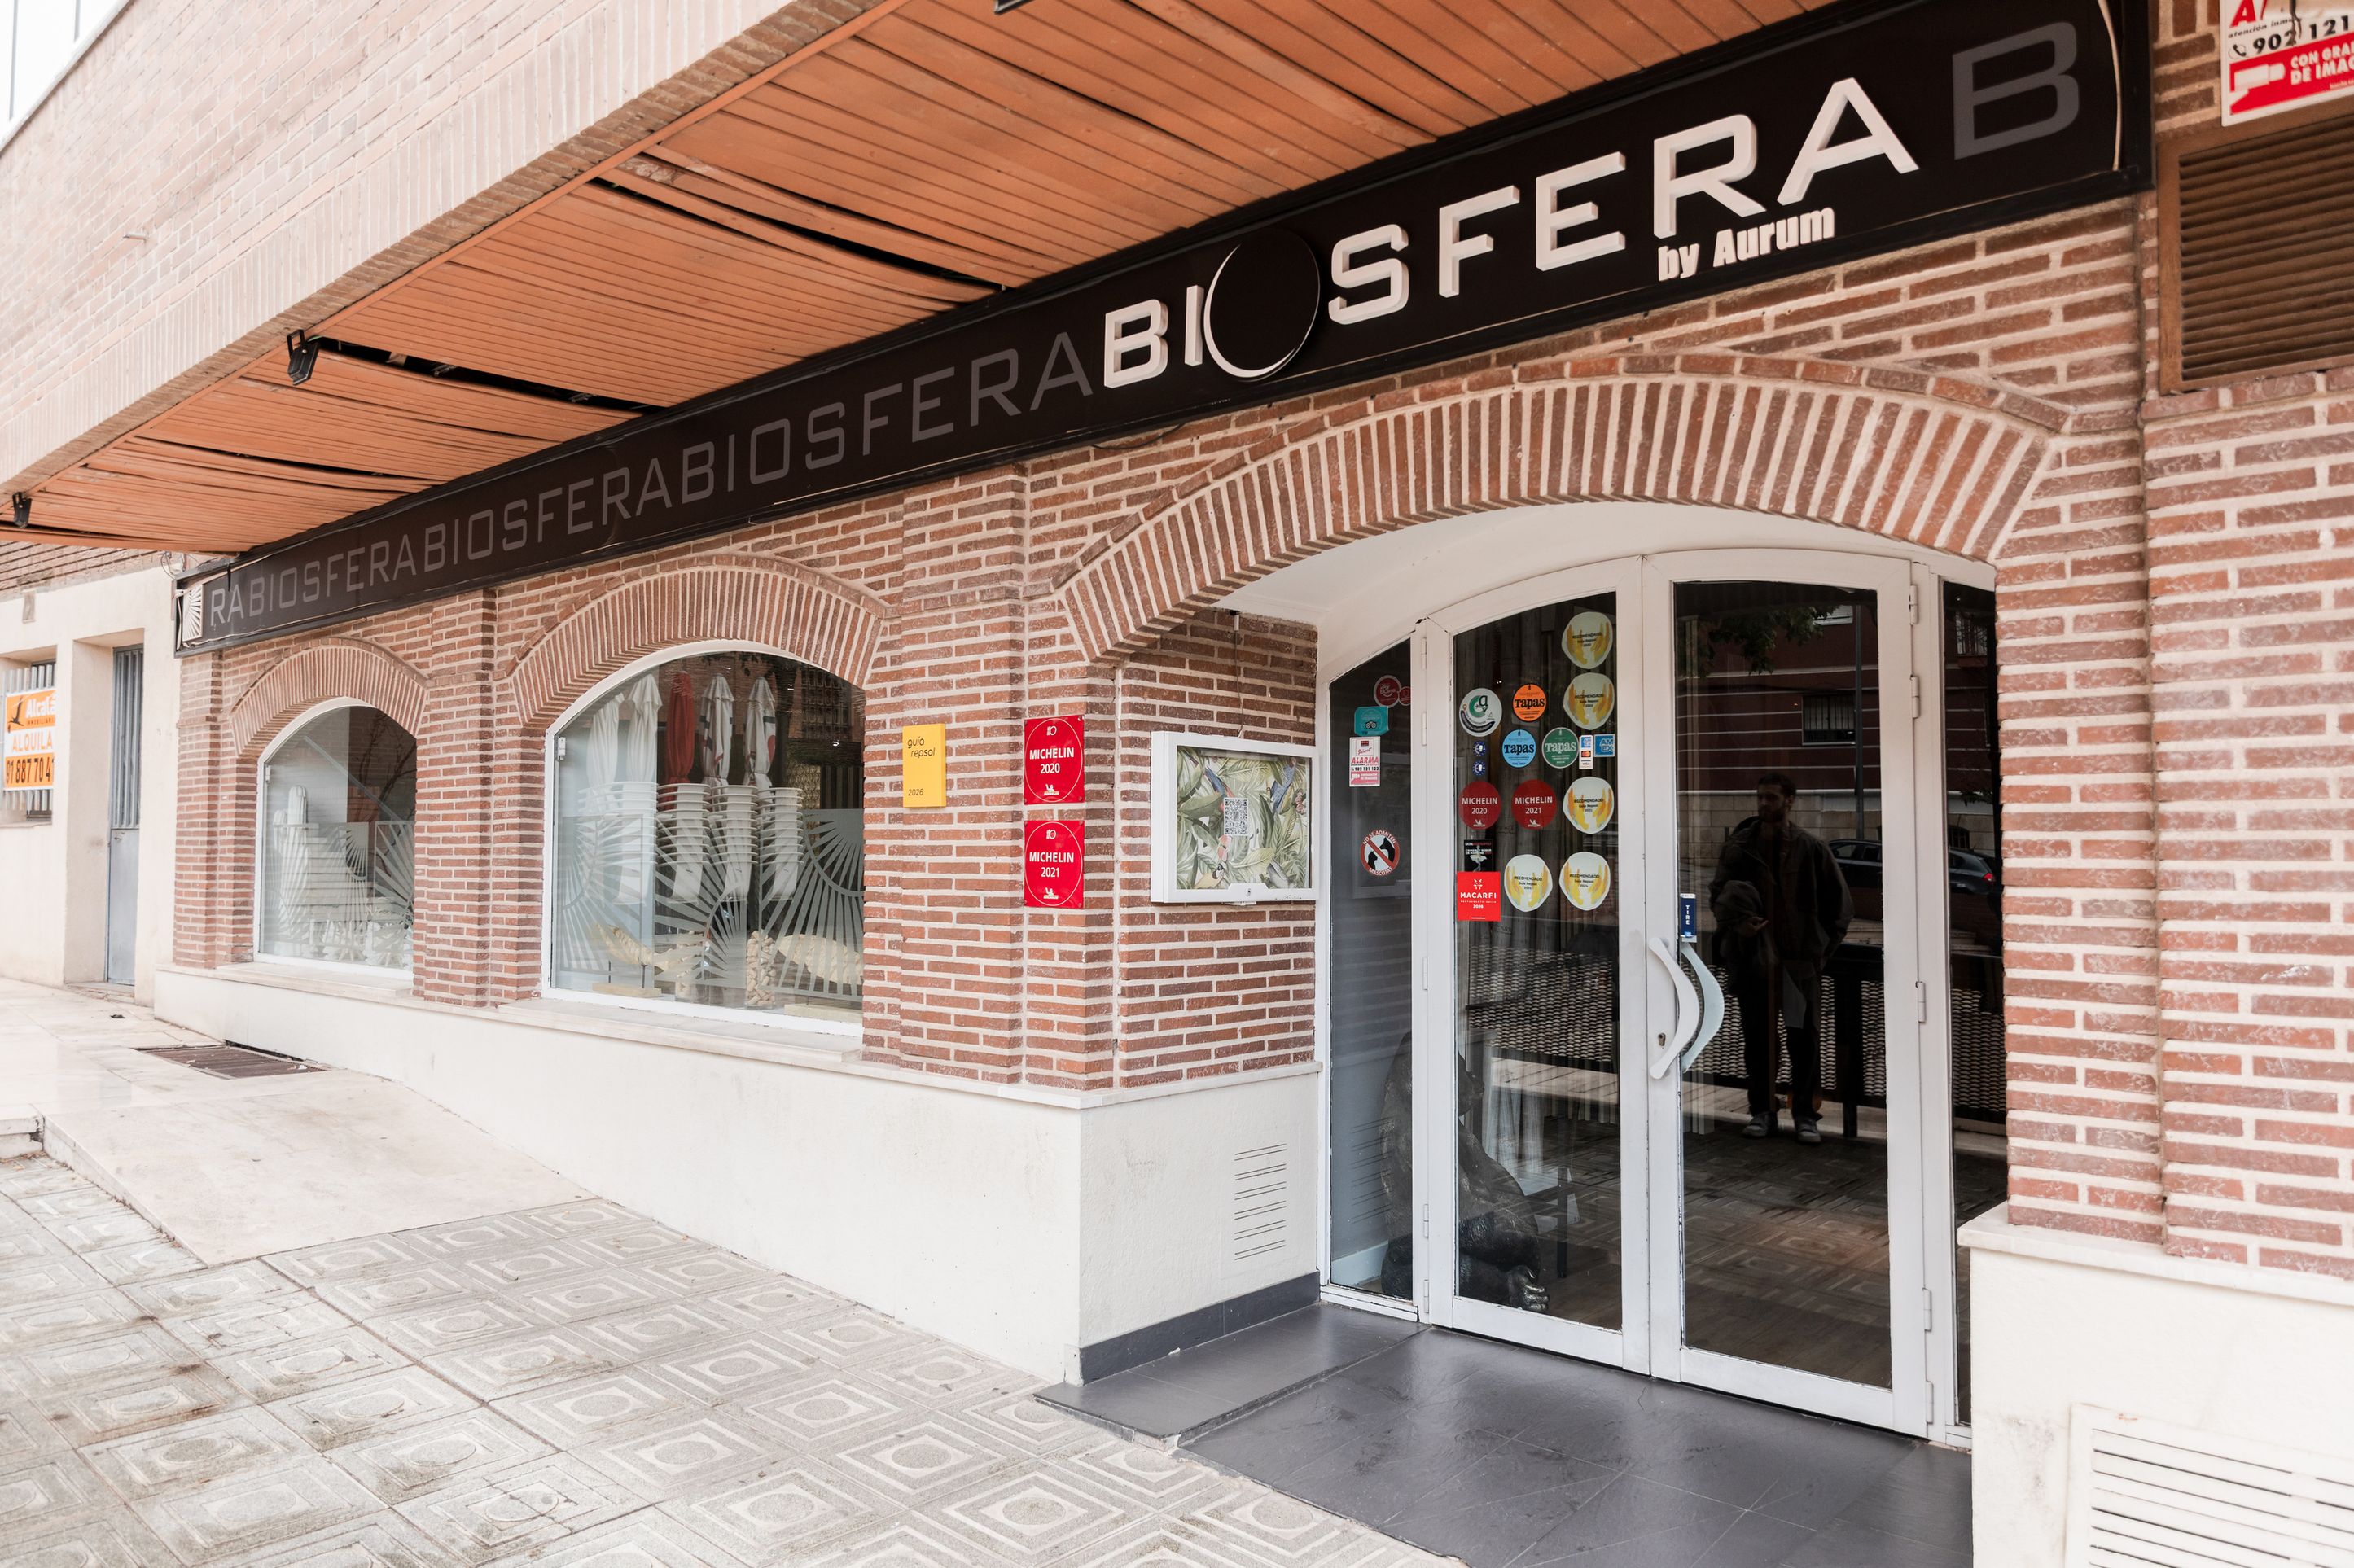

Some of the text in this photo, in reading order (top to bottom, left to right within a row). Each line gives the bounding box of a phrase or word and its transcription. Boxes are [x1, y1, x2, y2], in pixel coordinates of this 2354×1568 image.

[2253, 15, 2349, 54] 902 121
[2290, 50, 2319, 68] CON
[2290, 66, 2312, 85] DE
[1104, 77, 1919, 388] BIOSFERA
[1658, 207, 1835, 282] by Aurum
[12, 730, 53, 751] ALQUILA
[907, 736, 925, 749] guía
[910, 747, 936, 759] repsol
[1029, 747, 1075, 760] MICHELIN
[15, 757, 32, 783] 887
[34, 756, 44, 782] 70
[1040, 763, 1060, 774] 2020
[908, 788, 923, 796] 2026
[1515, 796, 1553, 804] MICHELIN
[1375, 830, 1396, 844] ADMITEN
[1029, 852, 1074, 863] MICHELIN
[1041, 867, 1059, 878] 2021
[1369, 865, 1393, 876] MASCOTAS
